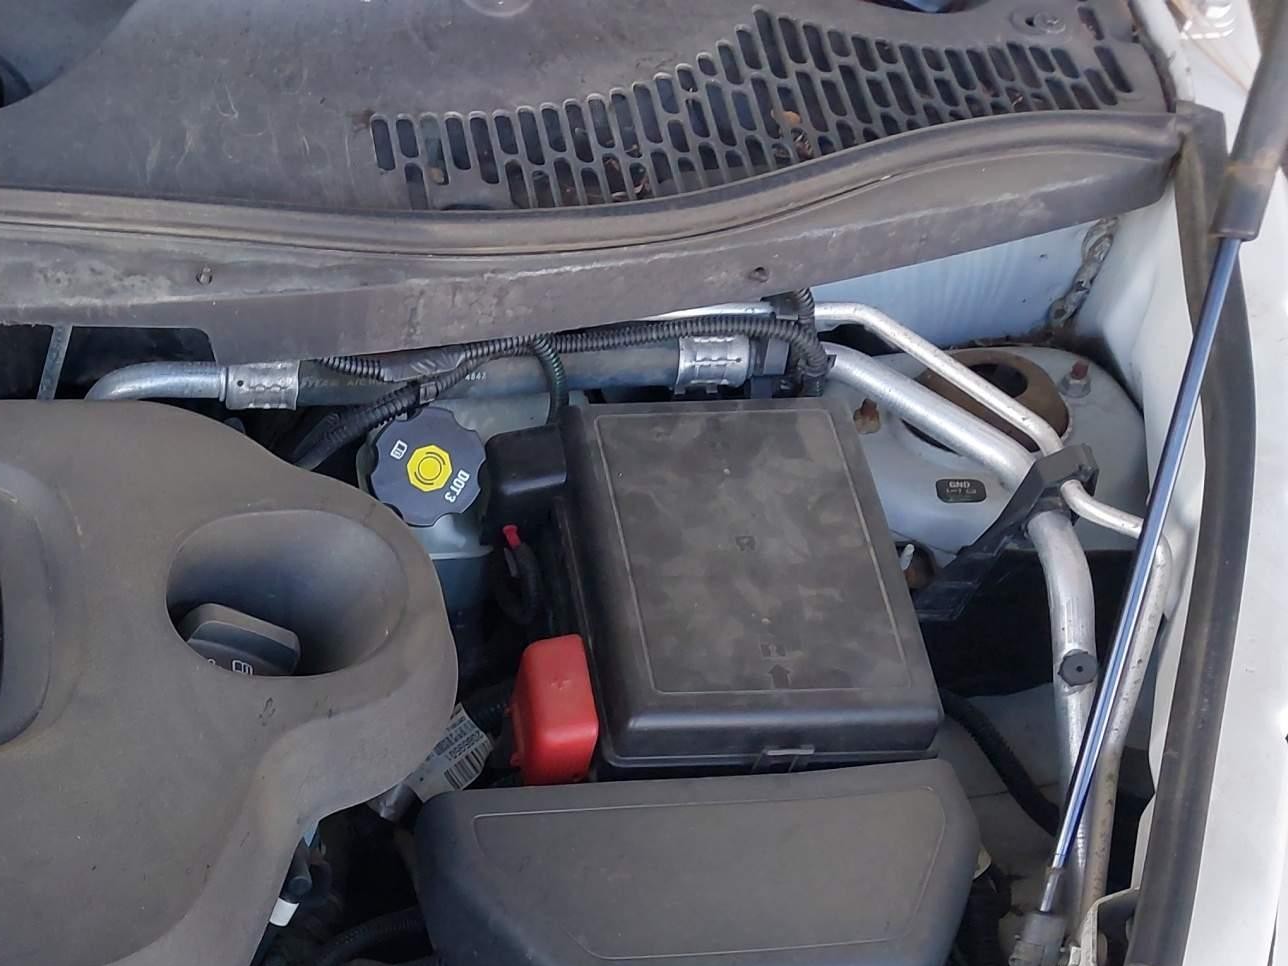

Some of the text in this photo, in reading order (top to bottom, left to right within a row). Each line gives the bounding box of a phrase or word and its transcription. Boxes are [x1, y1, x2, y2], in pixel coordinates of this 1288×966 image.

[444, 469, 471, 503] DOT 3
[948, 480, 971, 489] GND
